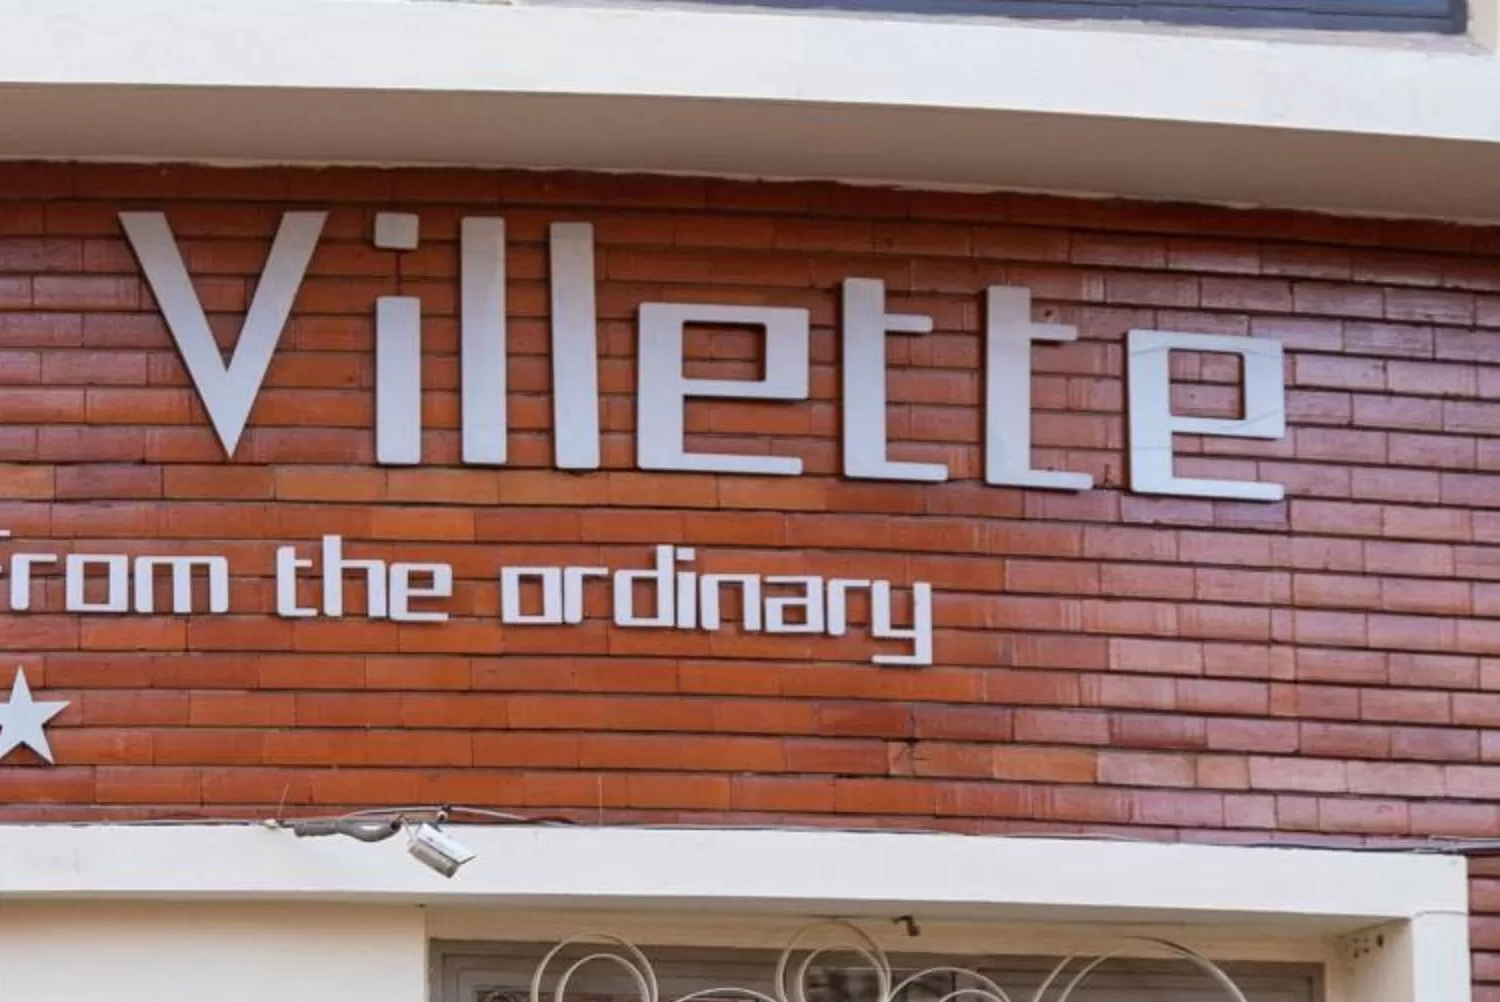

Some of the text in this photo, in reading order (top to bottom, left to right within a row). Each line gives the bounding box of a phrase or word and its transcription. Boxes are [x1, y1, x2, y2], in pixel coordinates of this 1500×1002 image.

[118, 211, 1285, 502] Villette
[276, 533, 453, 623] the
[501, 543, 933, 666] ordinary
